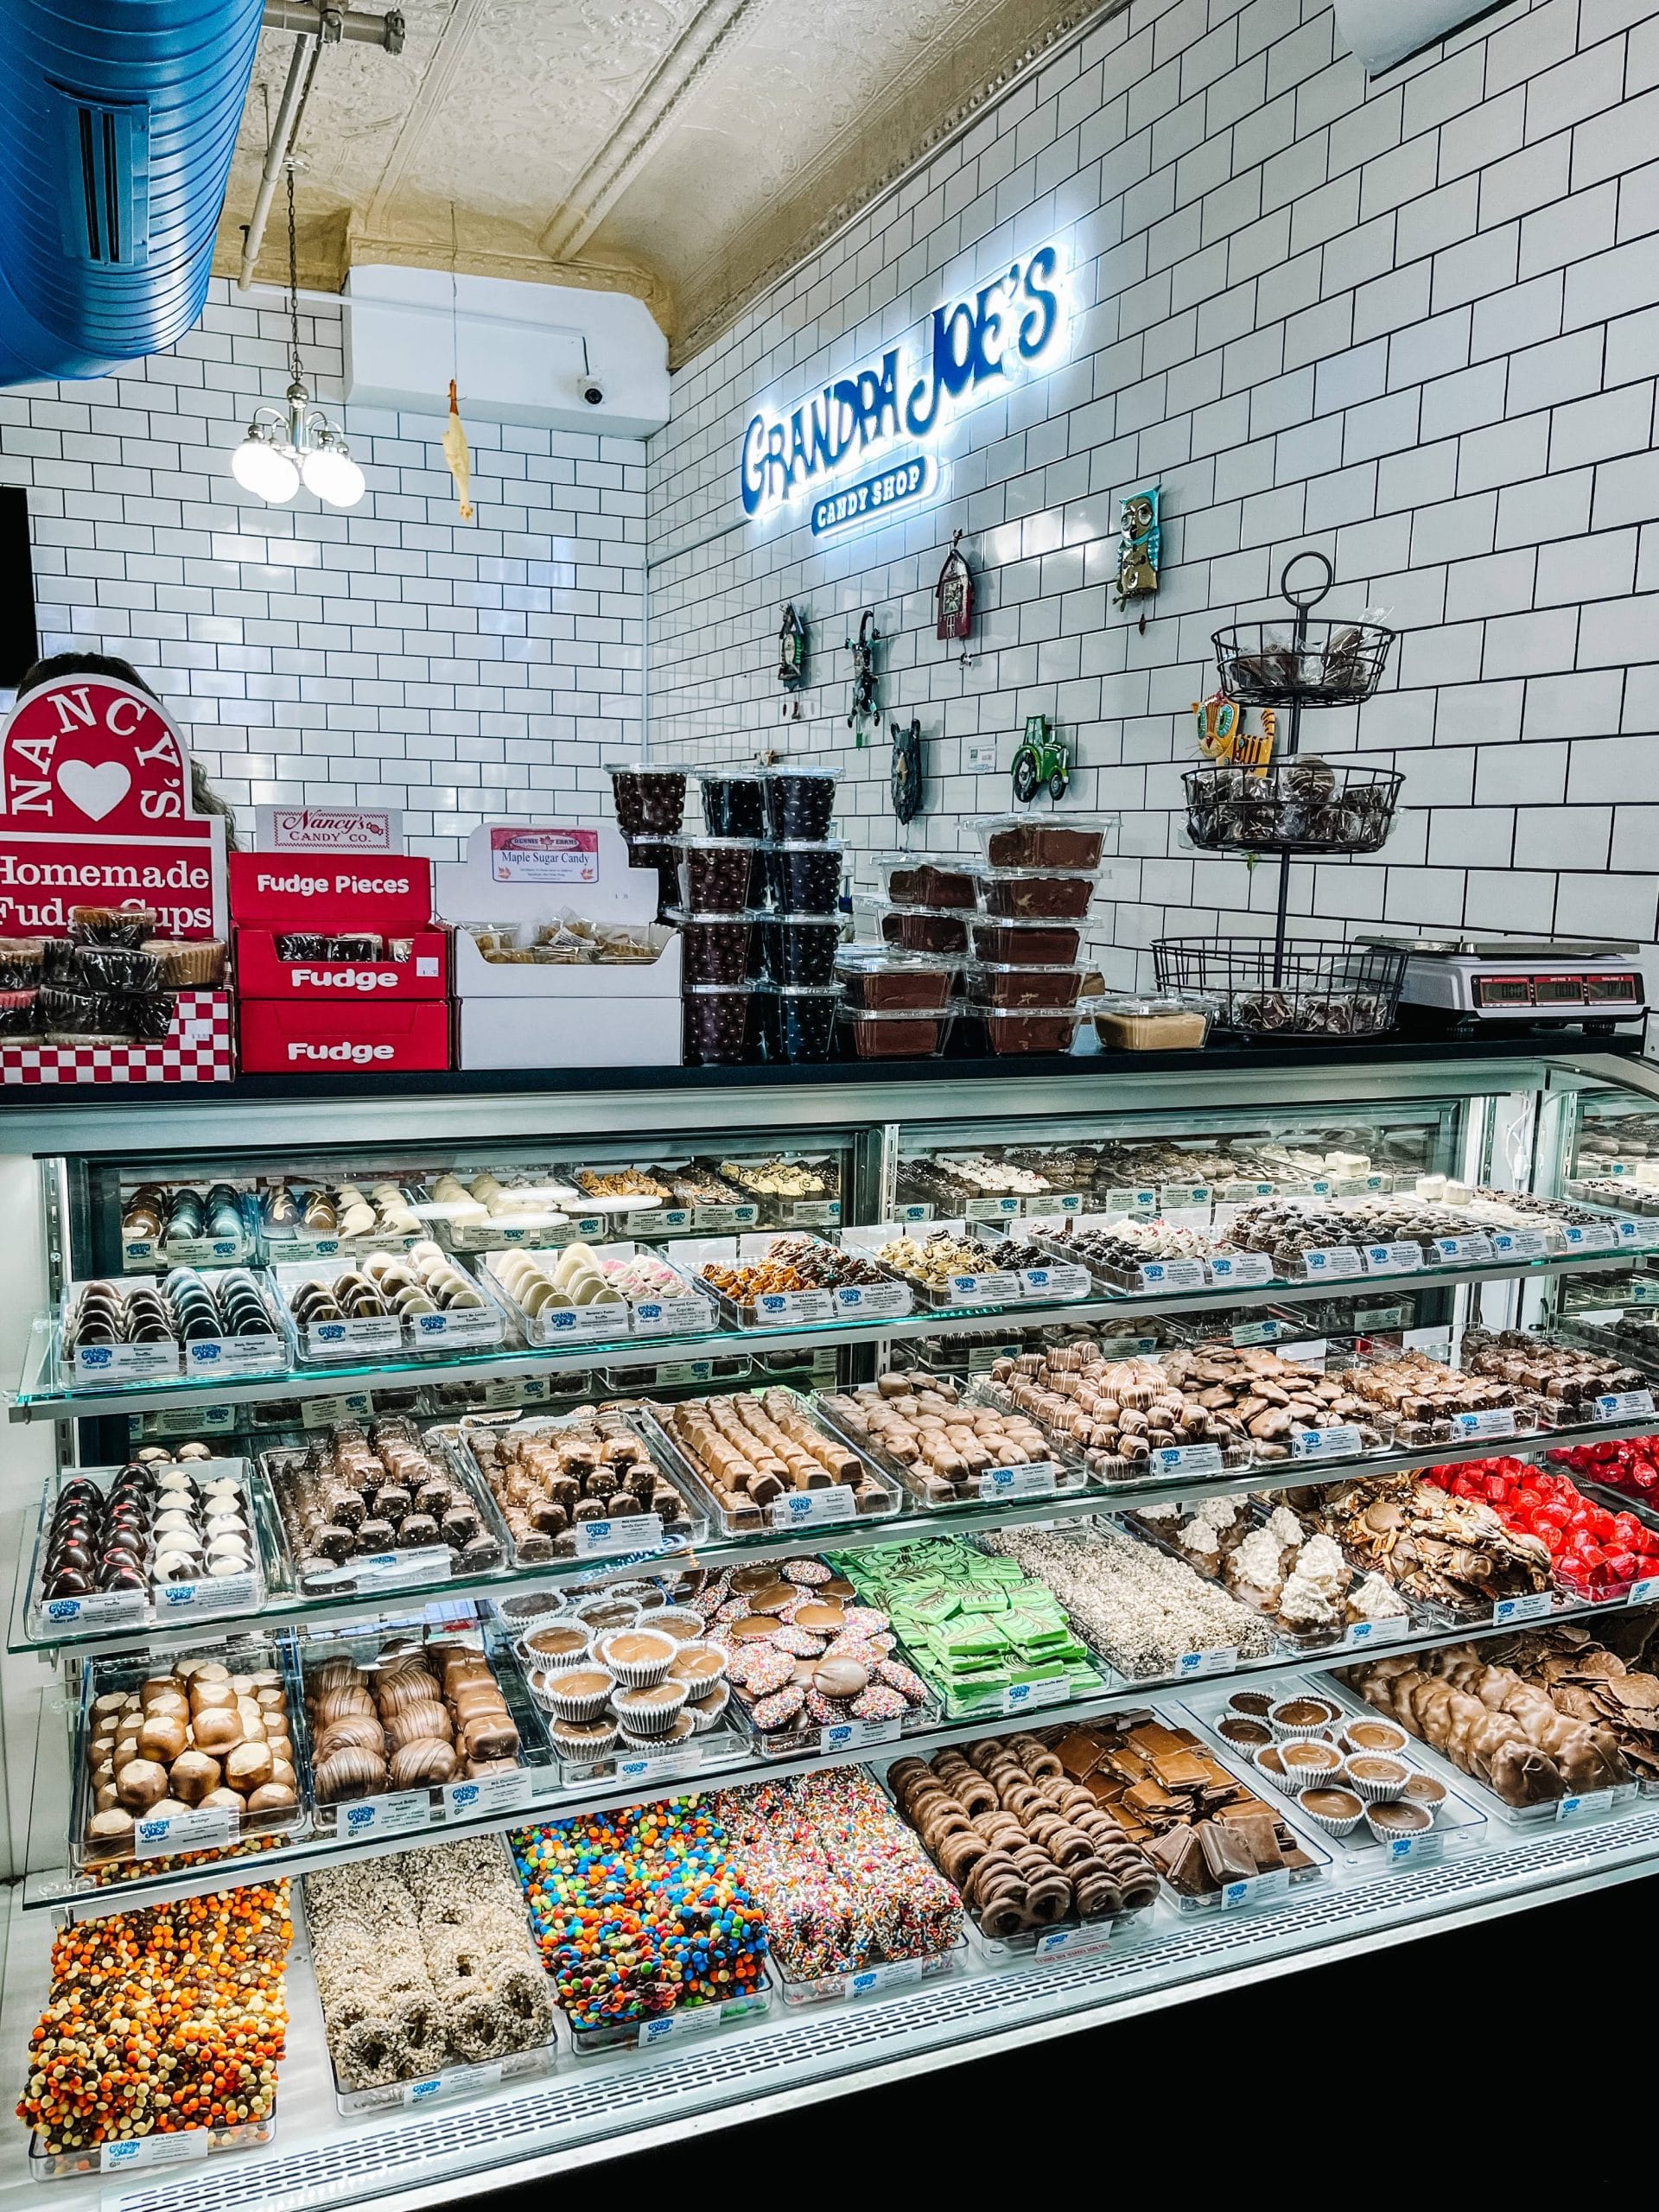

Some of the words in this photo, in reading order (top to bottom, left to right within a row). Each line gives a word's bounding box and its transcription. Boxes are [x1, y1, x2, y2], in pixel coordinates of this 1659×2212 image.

[742, 346, 903, 517] GRANDPA
[906, 247, 1058, 438] JOE'S
[817, 486, 868, 528] CANDY
[871, 469, 921, 506] SHOP
[10, 687, 181, 818] NANCY'S
[283, 810, 364, 835] Nancy's
[289, 831, 341, 842] CANDY
[349, 834, 372, 842] CO.
[502, 851, 531, 865] Maple
[533, 852, 559, 865] Sugar
[561, 853, 589, 866] Candy
[257, 874, 329, 896] Fudge
[335, 875, 410, 893] Pieces
[291, 969, 398, 991] Fudge
[288, 1042, 395, 1064] Fudge
